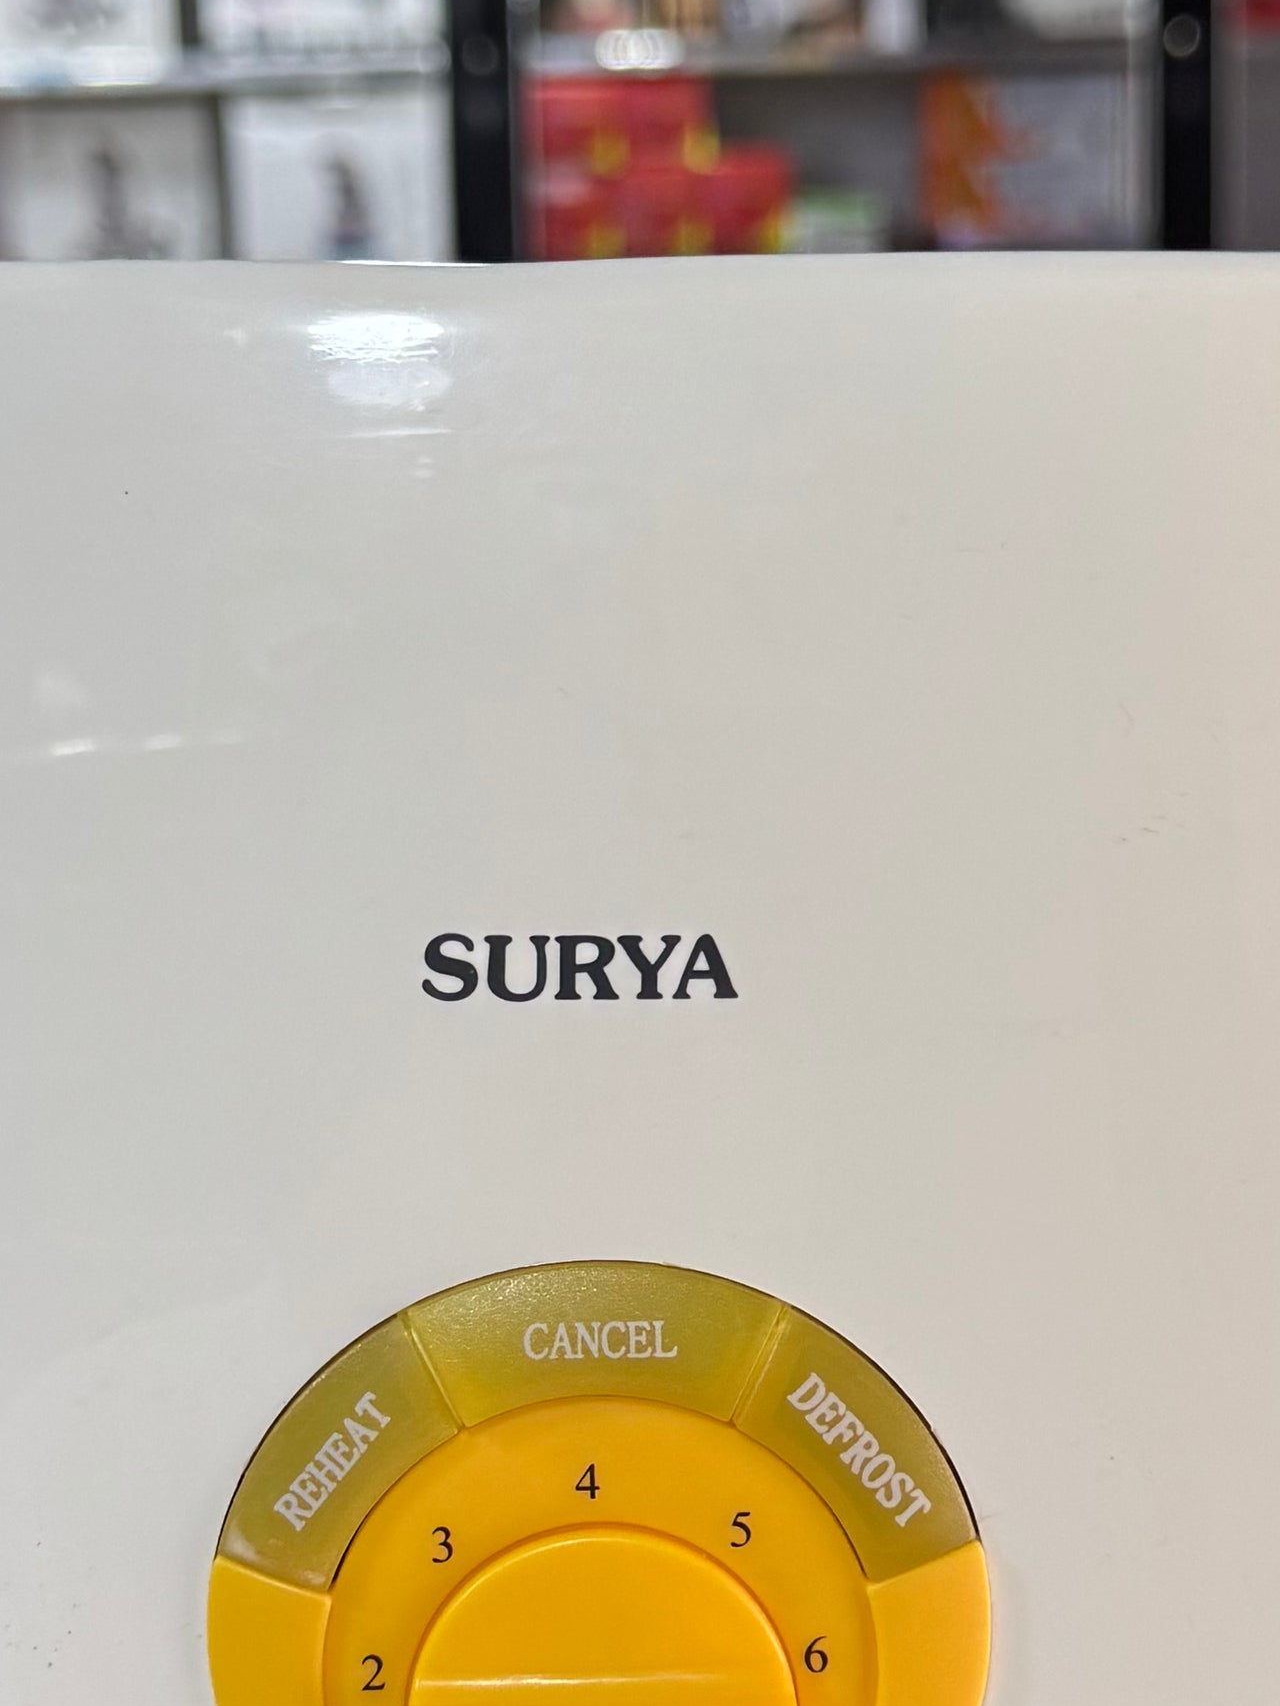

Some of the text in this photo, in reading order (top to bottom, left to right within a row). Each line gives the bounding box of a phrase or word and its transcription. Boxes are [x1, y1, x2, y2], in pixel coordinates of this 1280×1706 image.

[422, 933, 739, 1003] SURYA
[523, 1321, 677, 1361] CANCEL
[272, 1391, 392, 1531] REHEAT
[787, 1372, 932, 1527] DEFROST
[574, 1463, 601, 1500] 4
[431, 1526, 454, 1564] 3
[730, 1511, 752, 1548] 5
[361, 1653, 386, 1692] 2
[803, 1635, 830, 1674] 6
